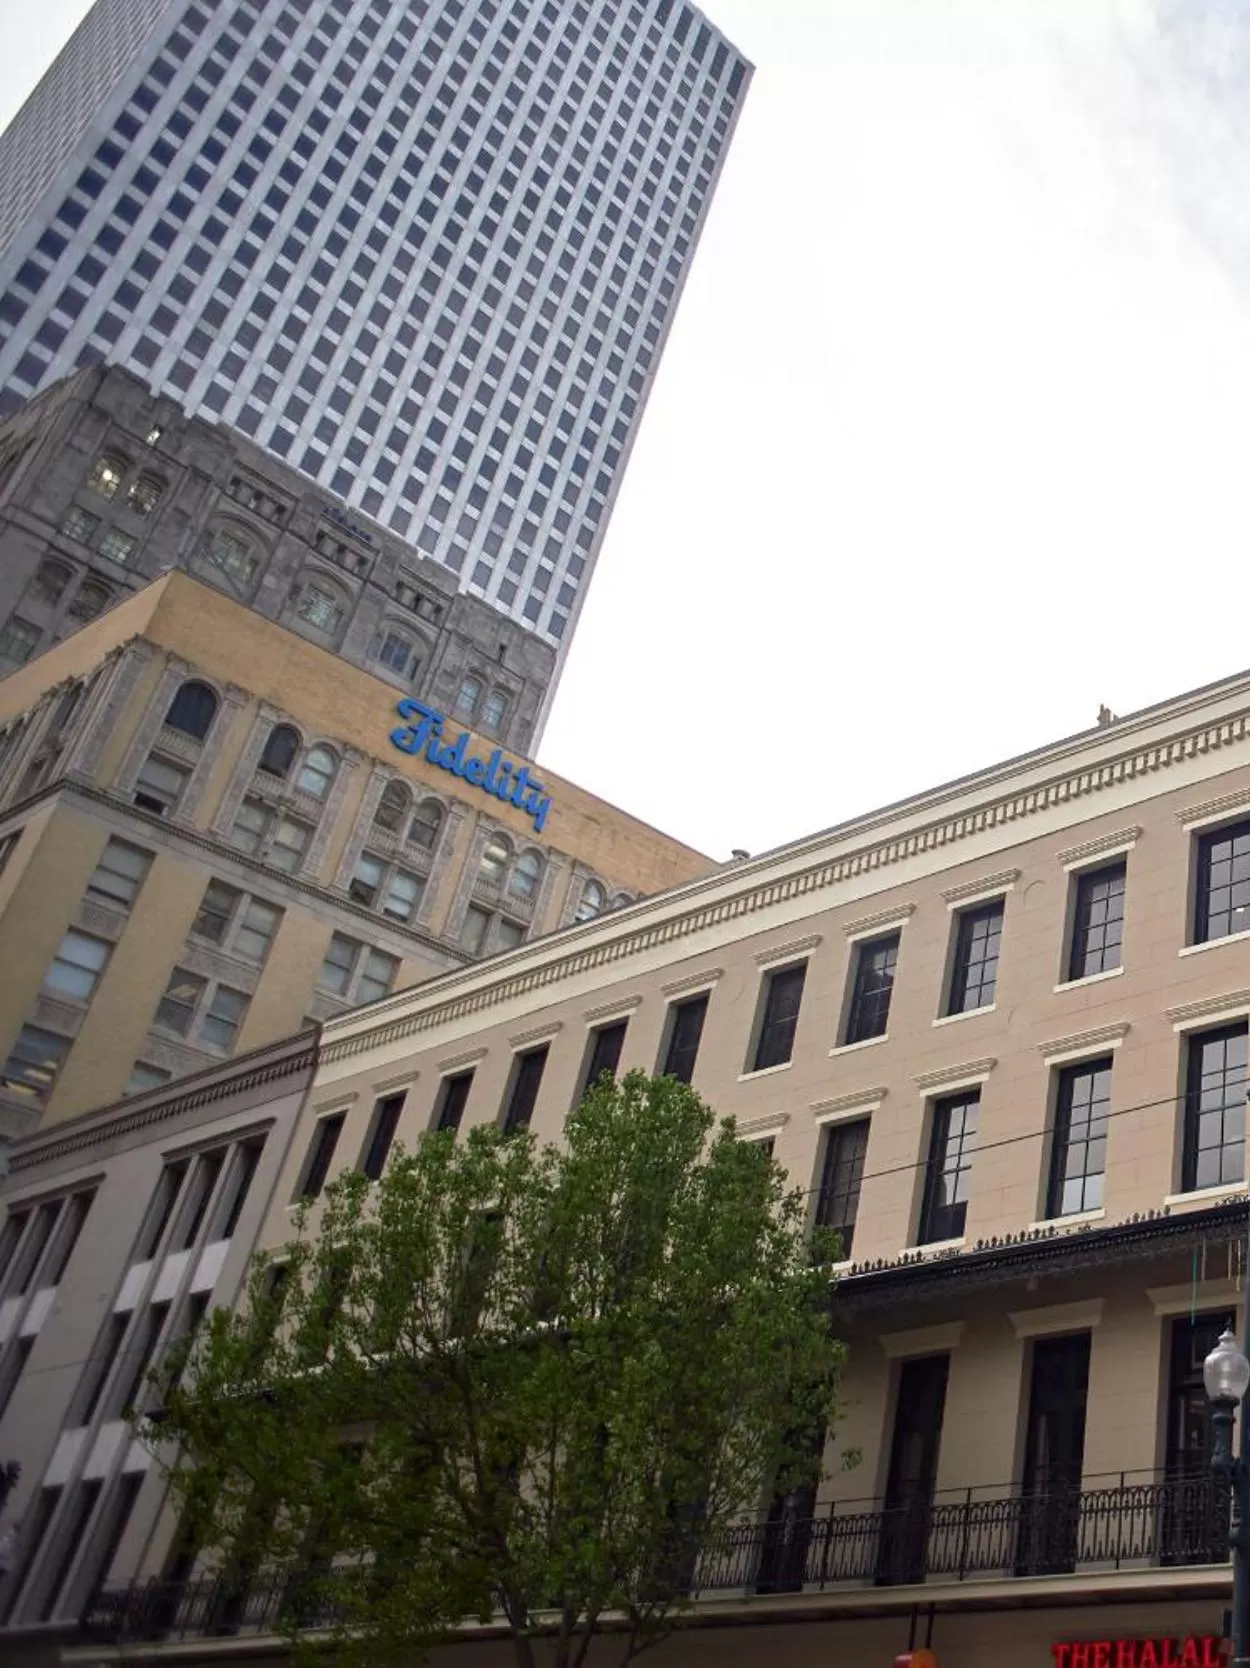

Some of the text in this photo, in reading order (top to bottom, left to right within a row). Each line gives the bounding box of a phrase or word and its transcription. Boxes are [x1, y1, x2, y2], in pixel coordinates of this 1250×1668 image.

[389, 697, 556, 833] Fidelity
[1052, 1641, 1111, 1668] THE
[1115, 1634, 1220, 1668] HALAL
